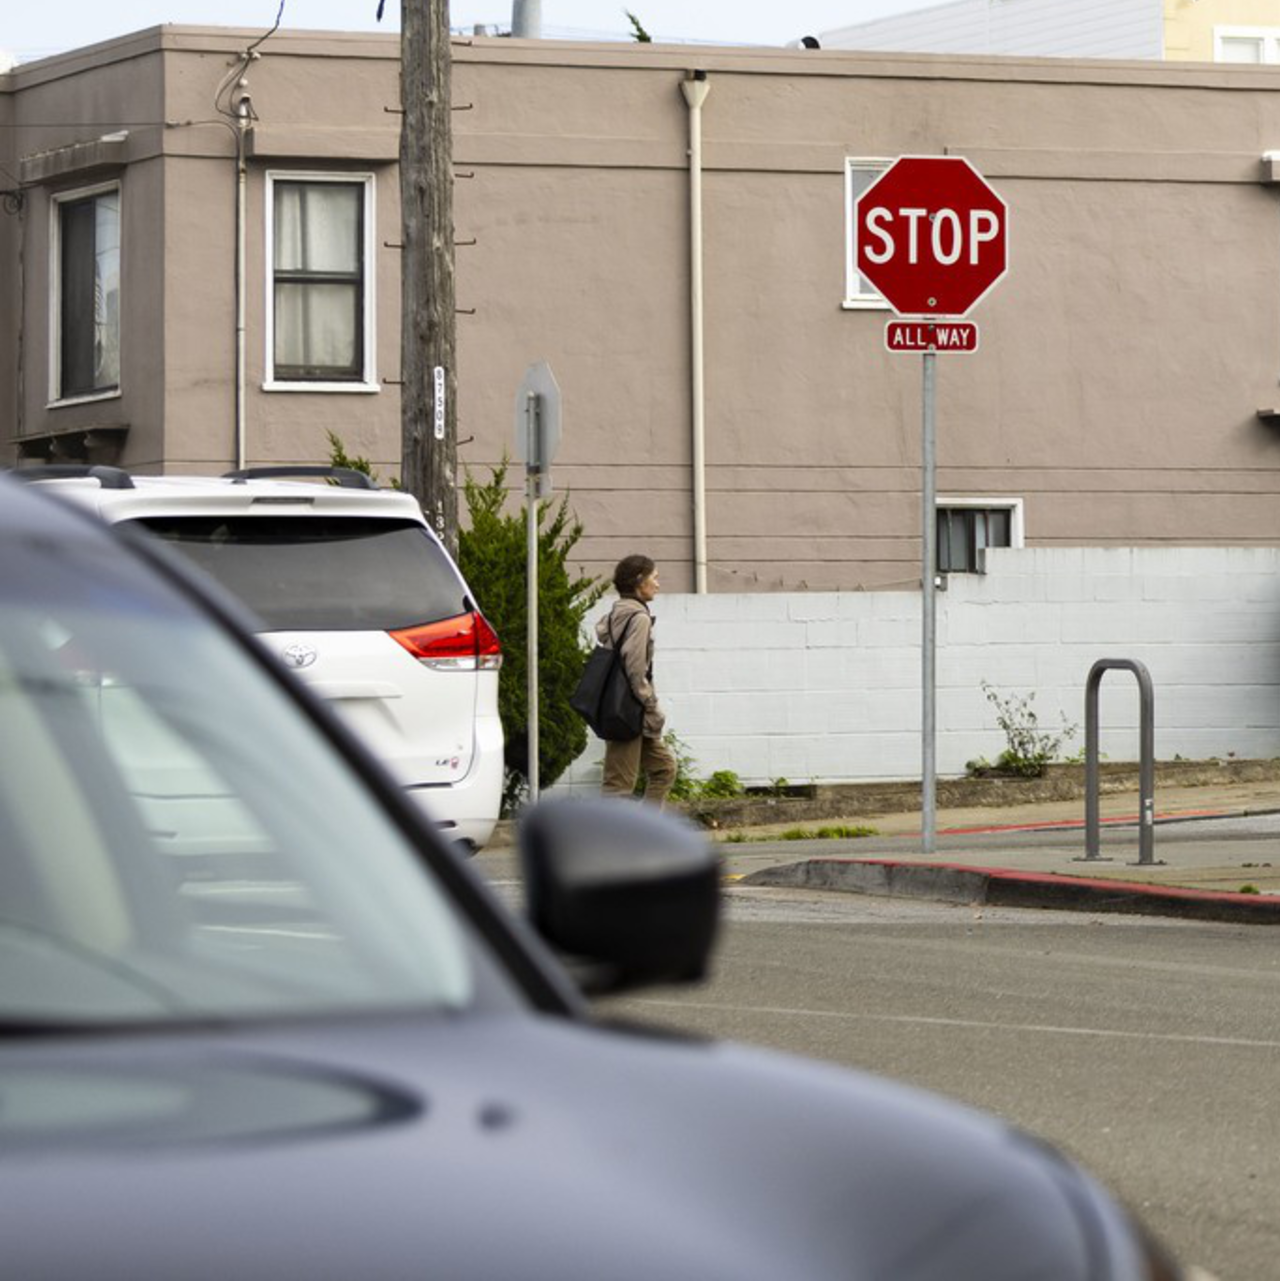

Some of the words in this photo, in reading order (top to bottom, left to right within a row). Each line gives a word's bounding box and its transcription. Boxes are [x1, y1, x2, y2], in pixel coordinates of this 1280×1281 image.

[863, 206, 1000, 265] STOP
[893, 328, 927, 346] ALL
[936, 328, 971, 347] WAY
